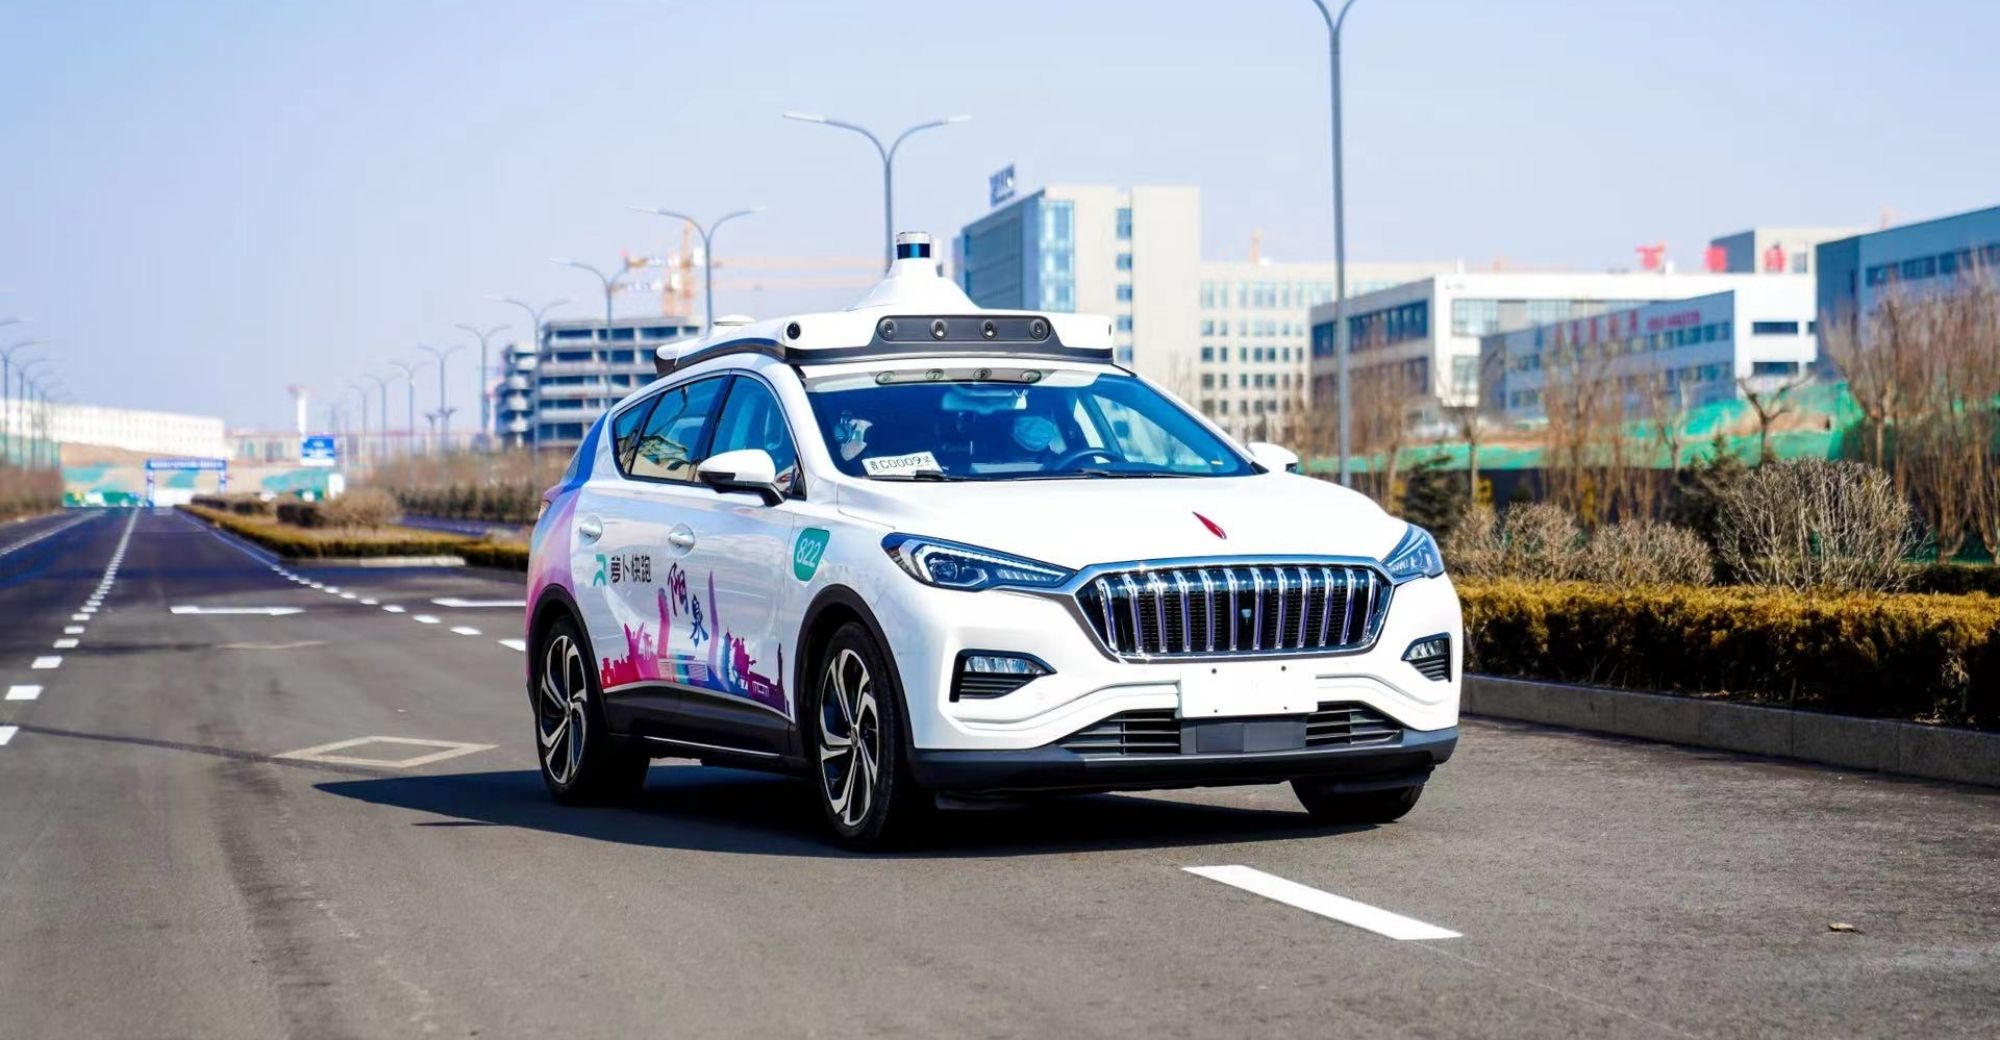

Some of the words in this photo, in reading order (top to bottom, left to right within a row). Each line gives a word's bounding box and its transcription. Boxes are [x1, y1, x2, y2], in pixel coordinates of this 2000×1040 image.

[797, 538, 821, 568] 822
[610, 554, 652, 583] 萝卜快跑
